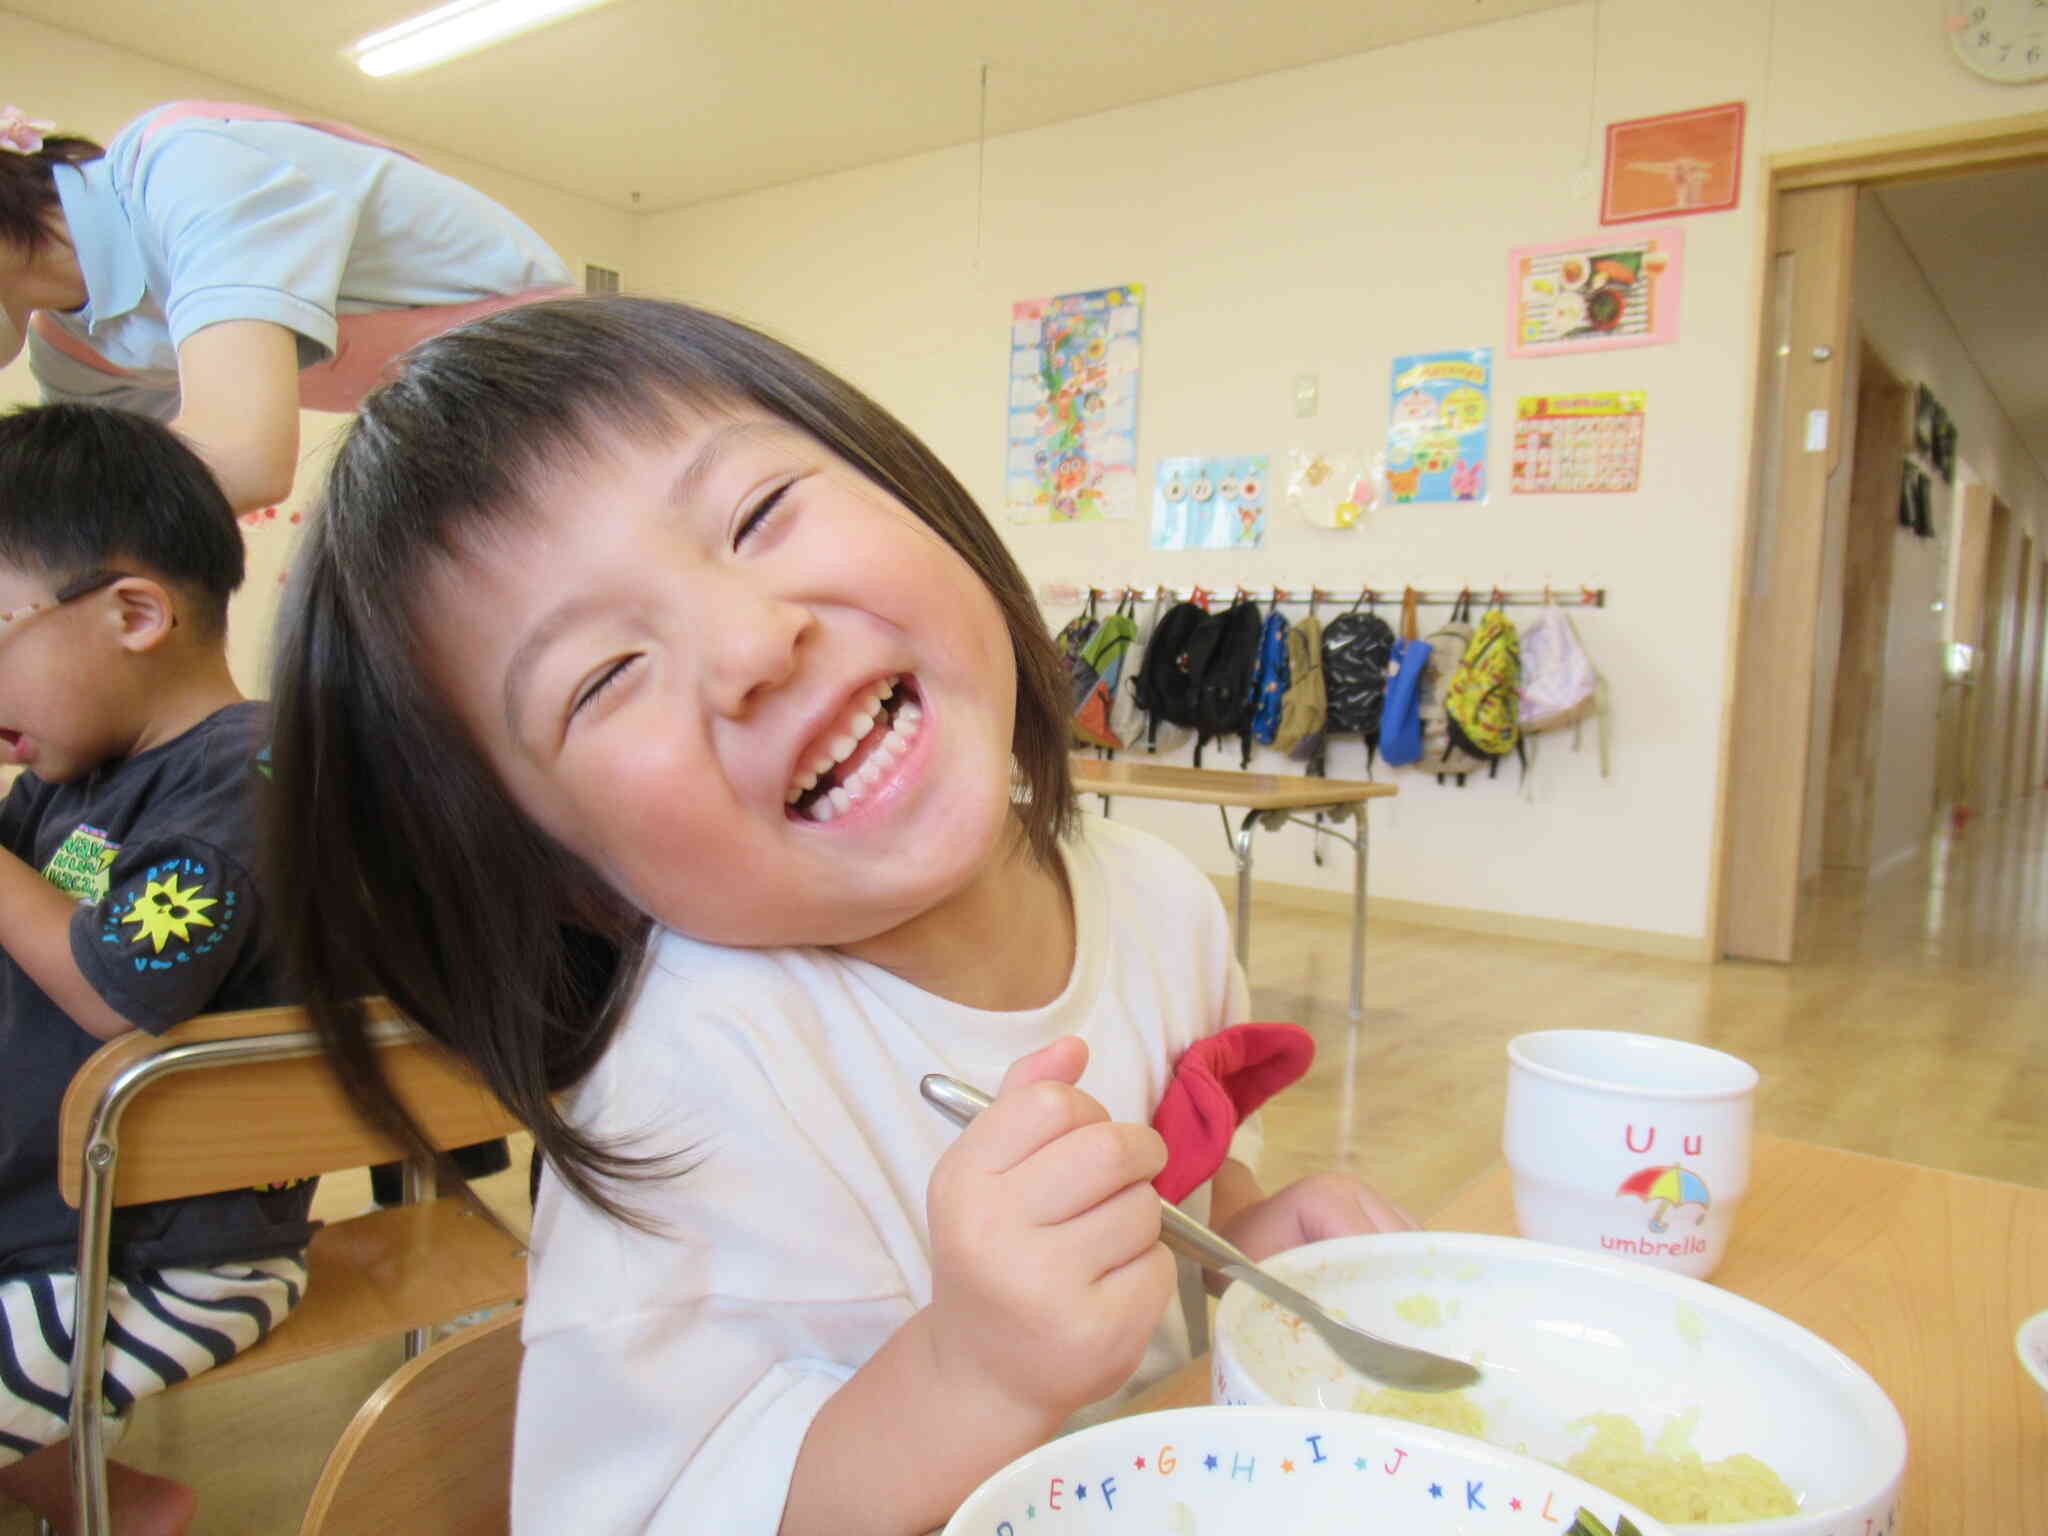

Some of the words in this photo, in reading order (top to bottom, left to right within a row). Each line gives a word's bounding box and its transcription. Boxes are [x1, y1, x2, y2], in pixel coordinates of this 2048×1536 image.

[1625, 1123, 1655, 1154] U
[1682, 1134, 1703, 1156] u
[1601, 1234, 1707, 1257] umbrella
[1049, 1478, 1065, 1511] E
[1100, 1476, 1118, 1511] F
[1157, 1444, 1177, 1476] G
[1231, 1451, 1256, 1483] H
[1305, 1434, 1327, 1464] I
[1384, 1447, 1409, 1476] J
[1466, 1480, 1487, 1511] K
[1541, 1491, 1560, 1523] L
